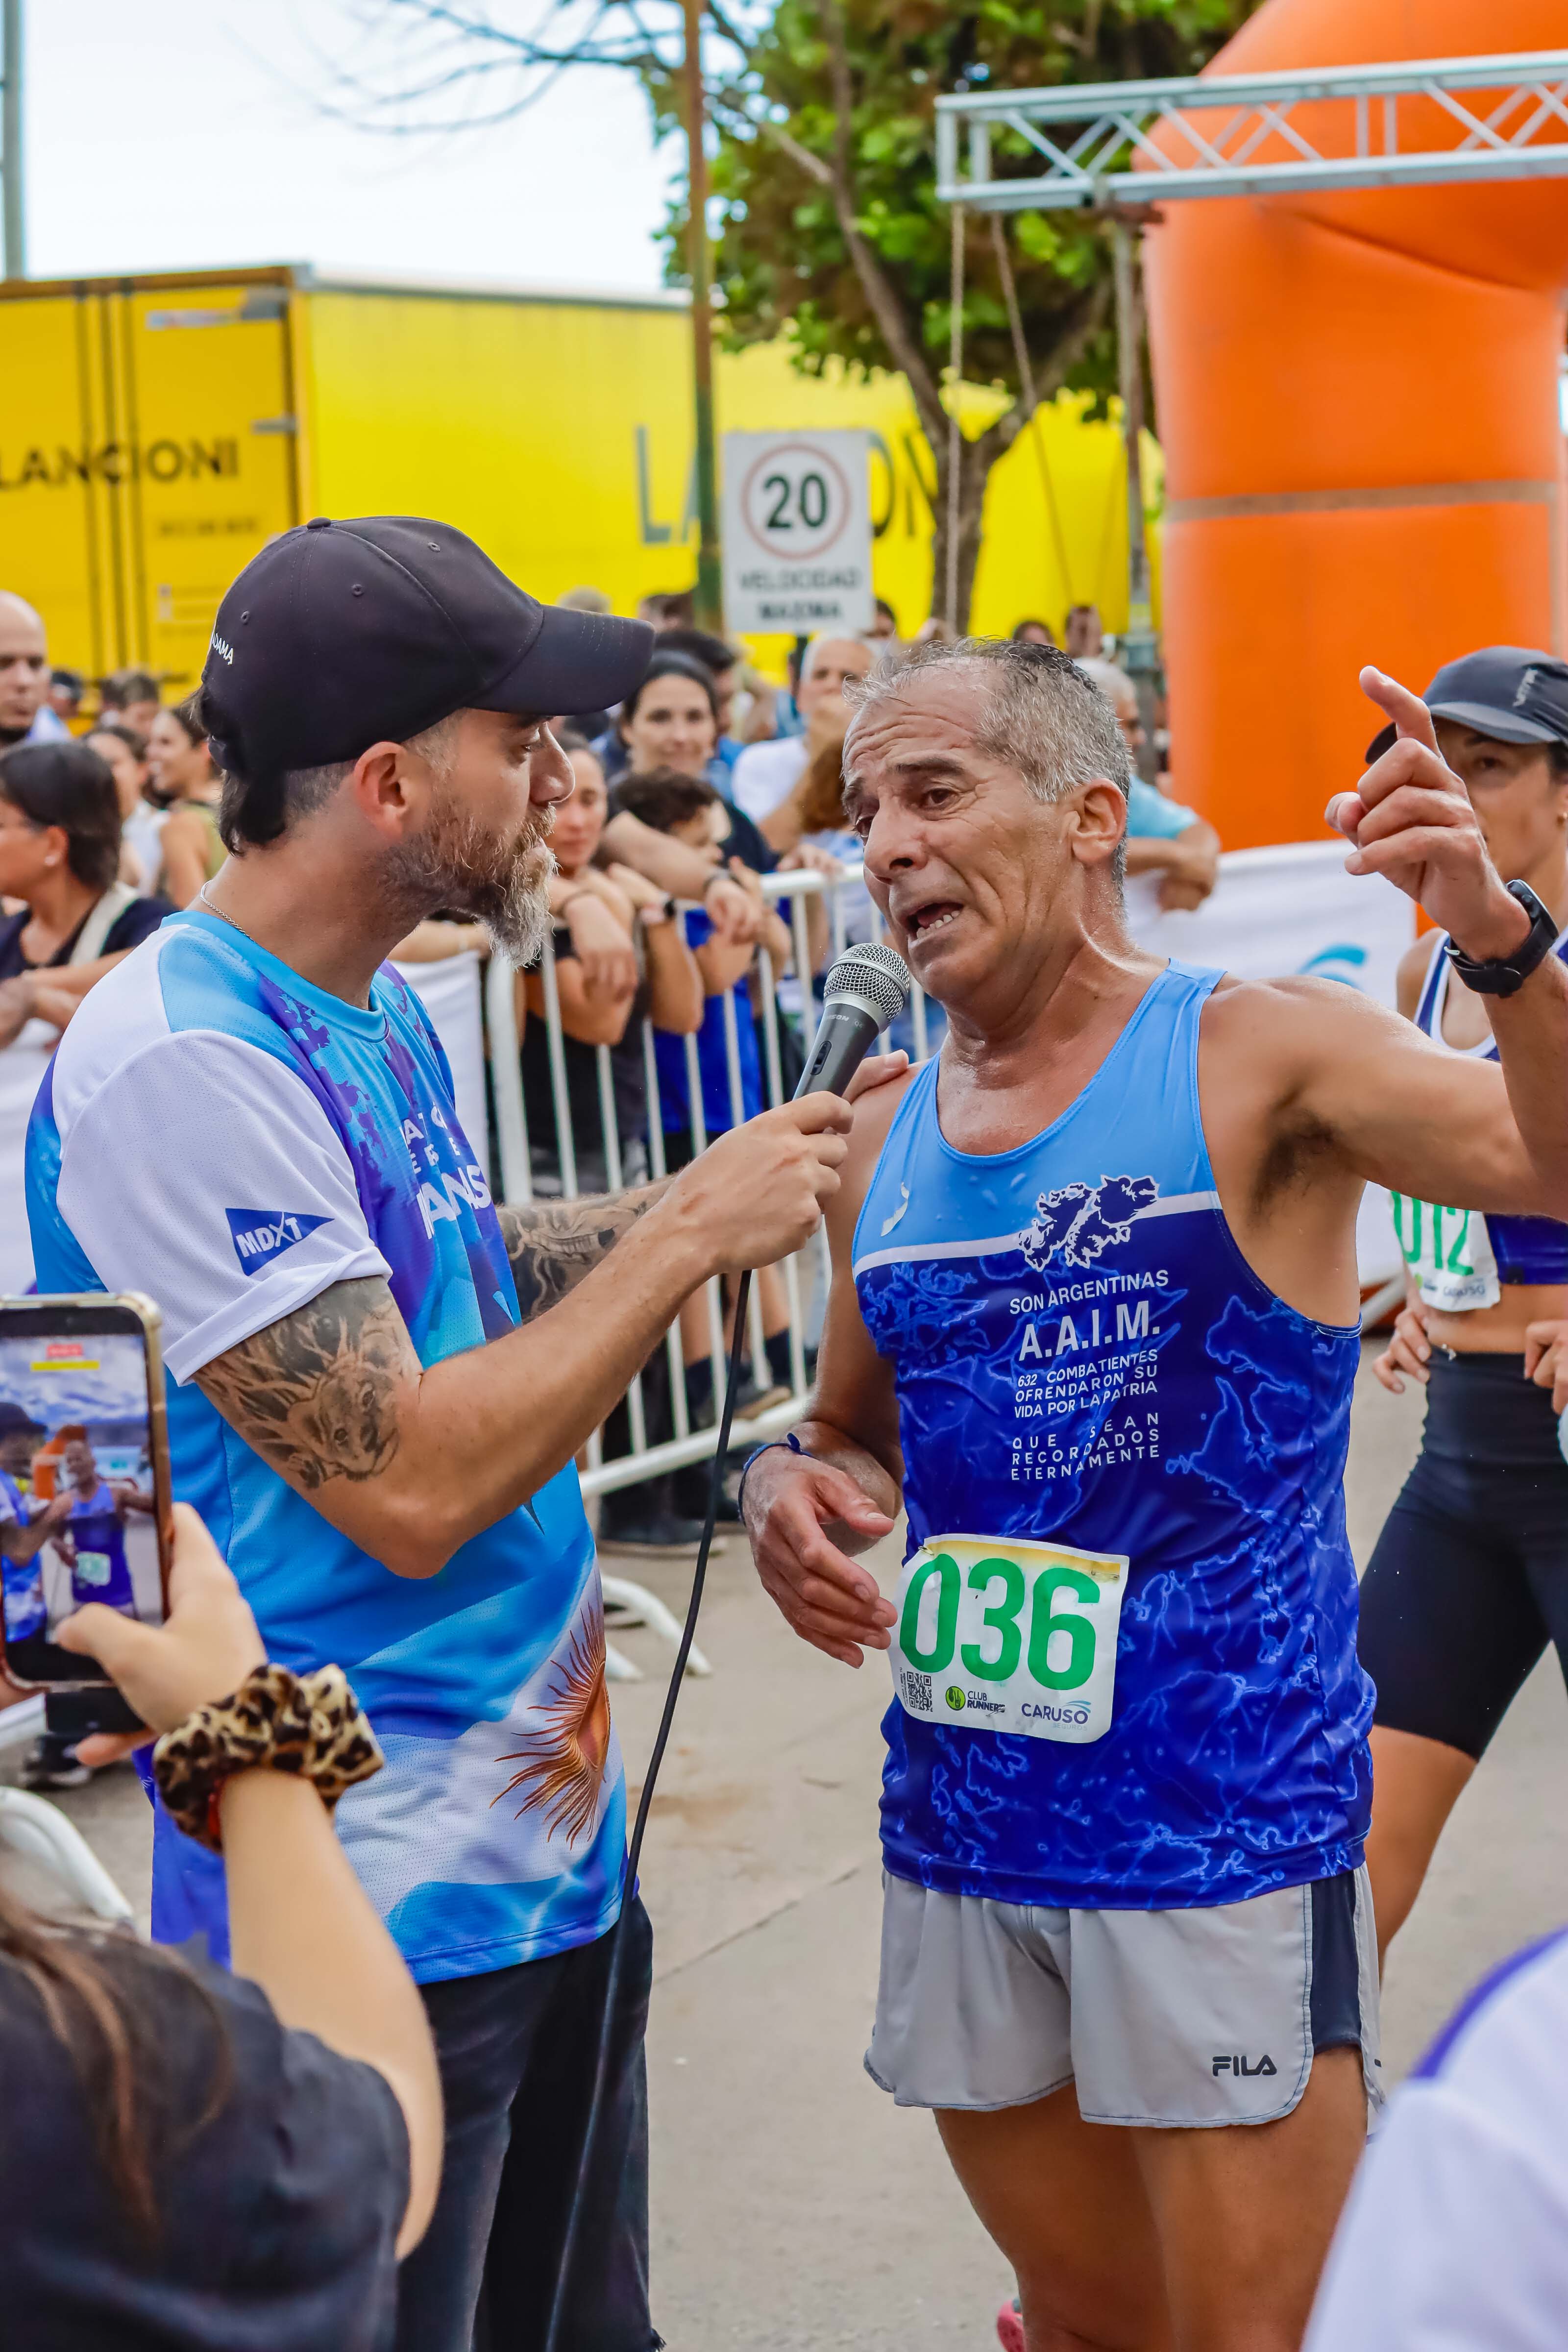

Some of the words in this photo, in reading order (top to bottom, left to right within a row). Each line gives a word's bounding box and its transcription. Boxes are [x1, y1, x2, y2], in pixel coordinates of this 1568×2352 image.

[763, 473, 829, 530] 20
[236, 1211, 302, 1258] MDXT
[1009, 1294, 1044, 1315] SON
[1048, 1270, 1169, 1307] ARGENTINAS
[1019, 1300, 1160, 1361] A.A.I.M.
[1015, 1372, 1124, 1402] OFRENDARON
[1134, 1365, 1157, 1379] SU
[1018, 1373, 1038, 1387] 632
[1047, 1349, 1158, 1383] COMBATIENTES
[1014, 1404, 1043, 1418] VIDA
[1048, 1399, 1076, 1415] POR
[1012, 1434, 1056, 1449] QUE
[1090, 1412, 1159, 1439] SEAN
[1012, 1429, 1159, 1465] RECORDADOS
[1011, 1445, 1160, 1480] ETERNAMENTE
[900, 1553, 1100, 1690] 036
[967, 1690, 987, 1701] CLUB
[1021, 1703, 1088, 1724] CARUSO
[1212, 2055, 1277, 2077] FILA
